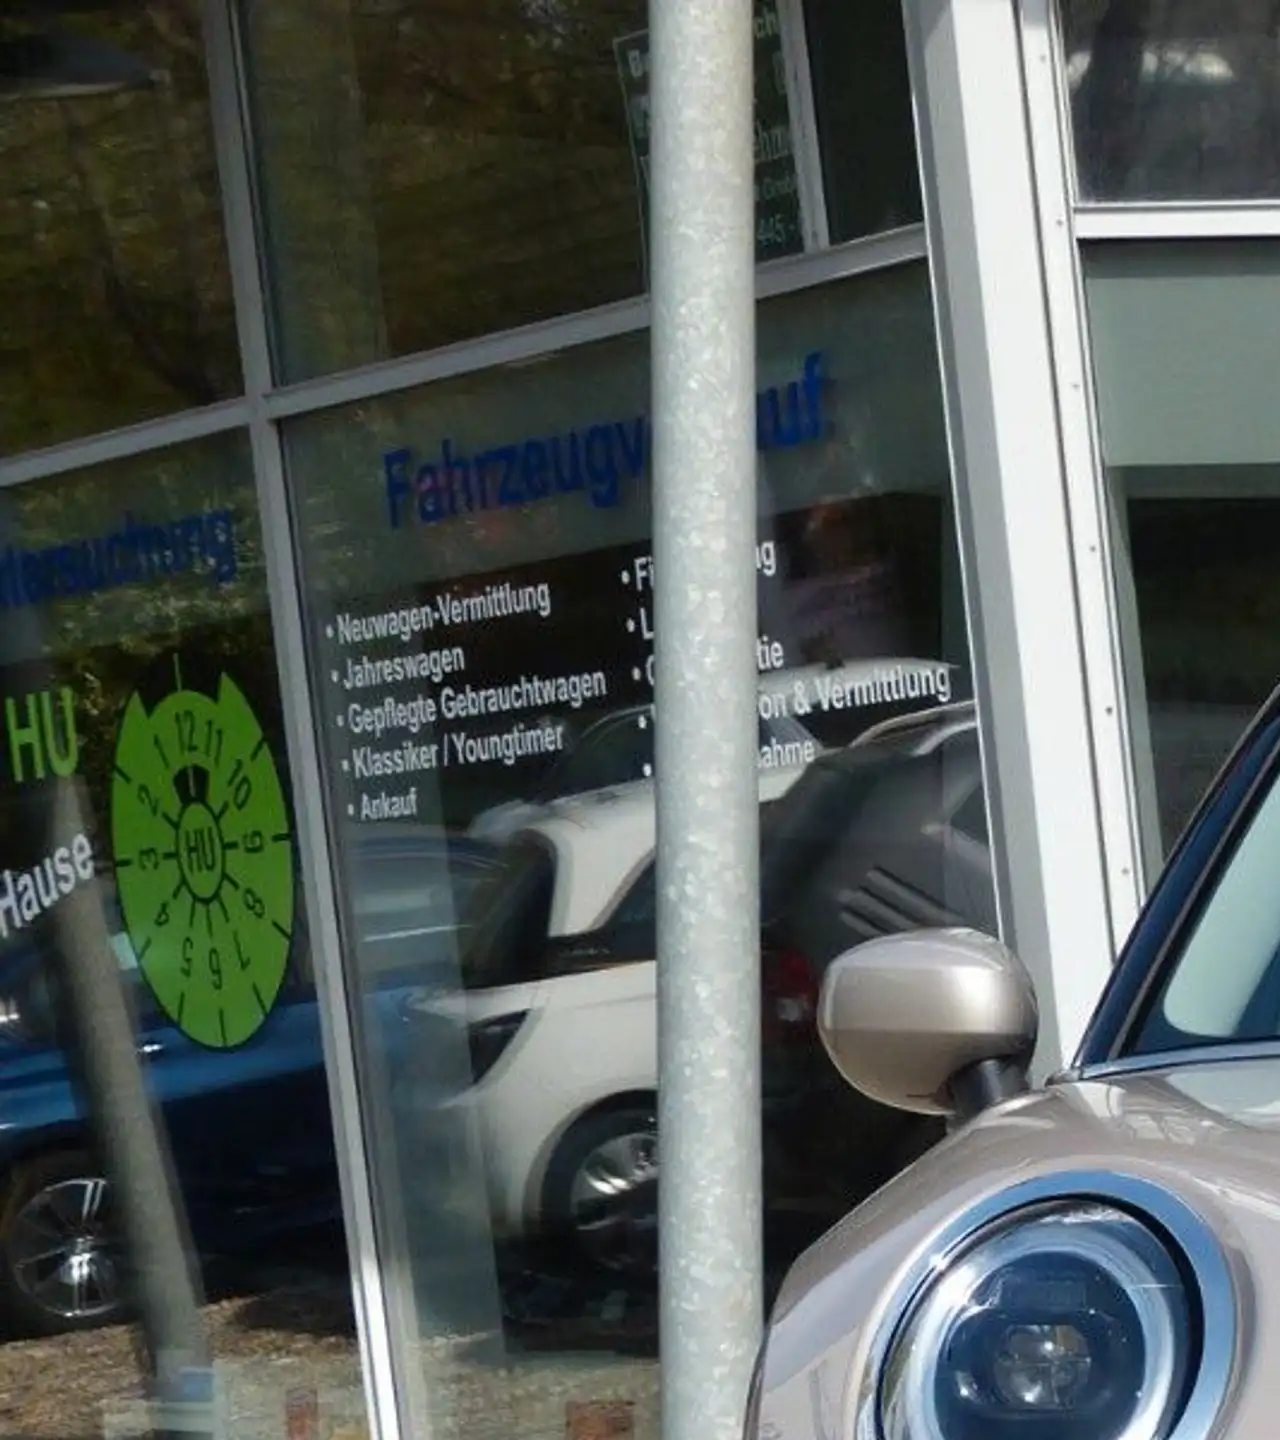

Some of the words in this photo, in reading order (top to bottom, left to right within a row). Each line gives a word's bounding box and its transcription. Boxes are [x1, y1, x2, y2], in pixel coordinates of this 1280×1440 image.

[336, 582, 551, 645] Neuwagen-Vermittlung
[343, 646, 465, 690] Jahreswagen
[814, 665, 951, 712] Vermittlung
[349, 693, 436, 738] Gepflegte
[440, 670, 607, 720] Gebrauchtwagen
[5, 684, 79, 783] HU
[352, 740, 440, 779] Klassiker
[452, 722, 565, 766] Youngtimer
[360, 787, 418, 821] Ankauf
[184, 825, 217, 874] HU
